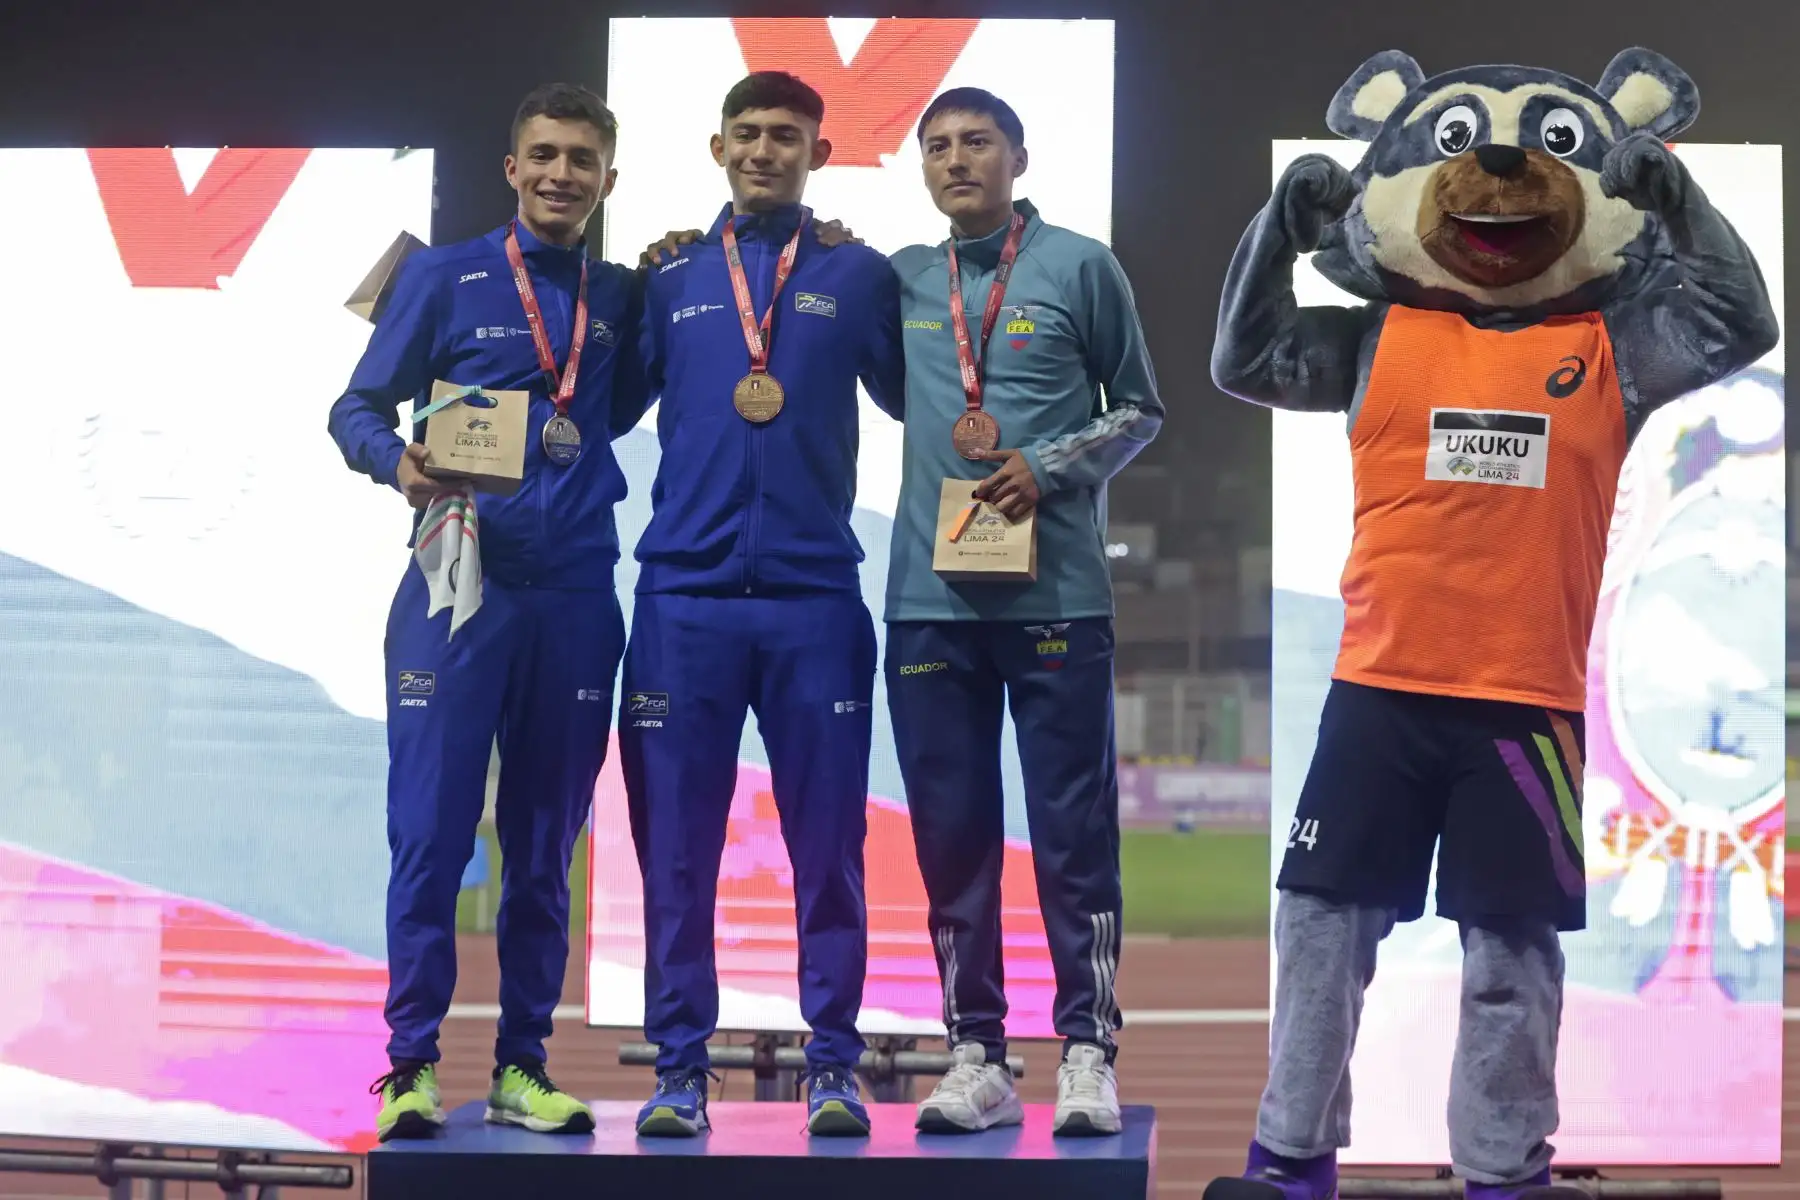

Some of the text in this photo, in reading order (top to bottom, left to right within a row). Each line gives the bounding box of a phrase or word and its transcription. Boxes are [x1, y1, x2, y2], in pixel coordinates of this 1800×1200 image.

[659, 257, 690, 274] SAETA
[459, 271, 489, 284] SAETA
[816, 300, 834, 311] FCA
[903, 320, 944, 331] ECUADOR
[455, 437, 497, 448] LIMA 24
[1445, 434, 1529, 458] UKUKU
[1478, 469, 1519, 480] LIMA 24
[964, 535, 1005, 543] LIMA 24
[900, 662, 948, 675] ECUADOR
[414, 678, 432, 687] FCA
[399, 698, 428, 707] SAETA
[647, 699, 666, 708] FCA
[632, 719, 663, 728] SAETA
[1286, 816, 1320, 851] 24
